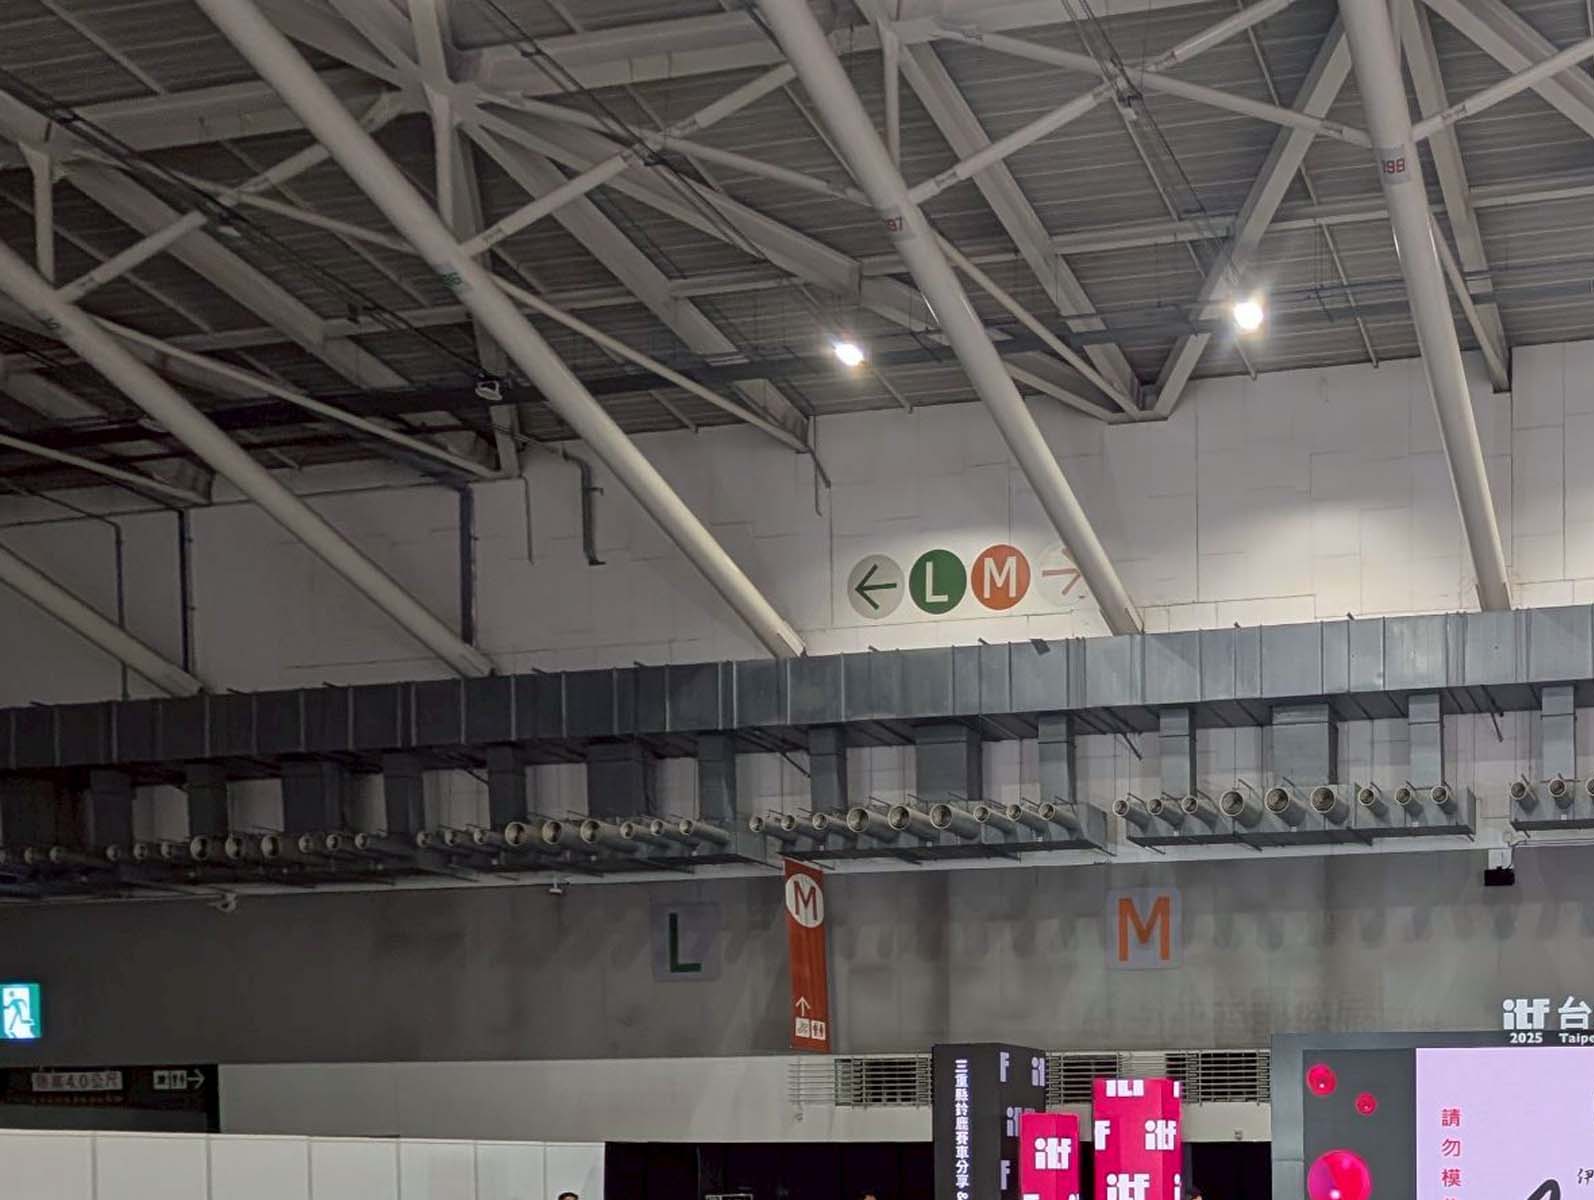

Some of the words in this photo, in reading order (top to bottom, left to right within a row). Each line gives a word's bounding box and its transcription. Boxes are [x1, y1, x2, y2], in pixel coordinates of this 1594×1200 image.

[925, 560, 949, 603] L
[983, 556, 1017, 599] M
[794, 880, 818, 912] M
[669, 913, 702, 973] L
[1119, 896, 1170, 961] M
[1503, 999, 1549, 1030] itf
[1510, 1032, 1543, 1044] 2025
[1034, 1138, 1071, 1169] itf
